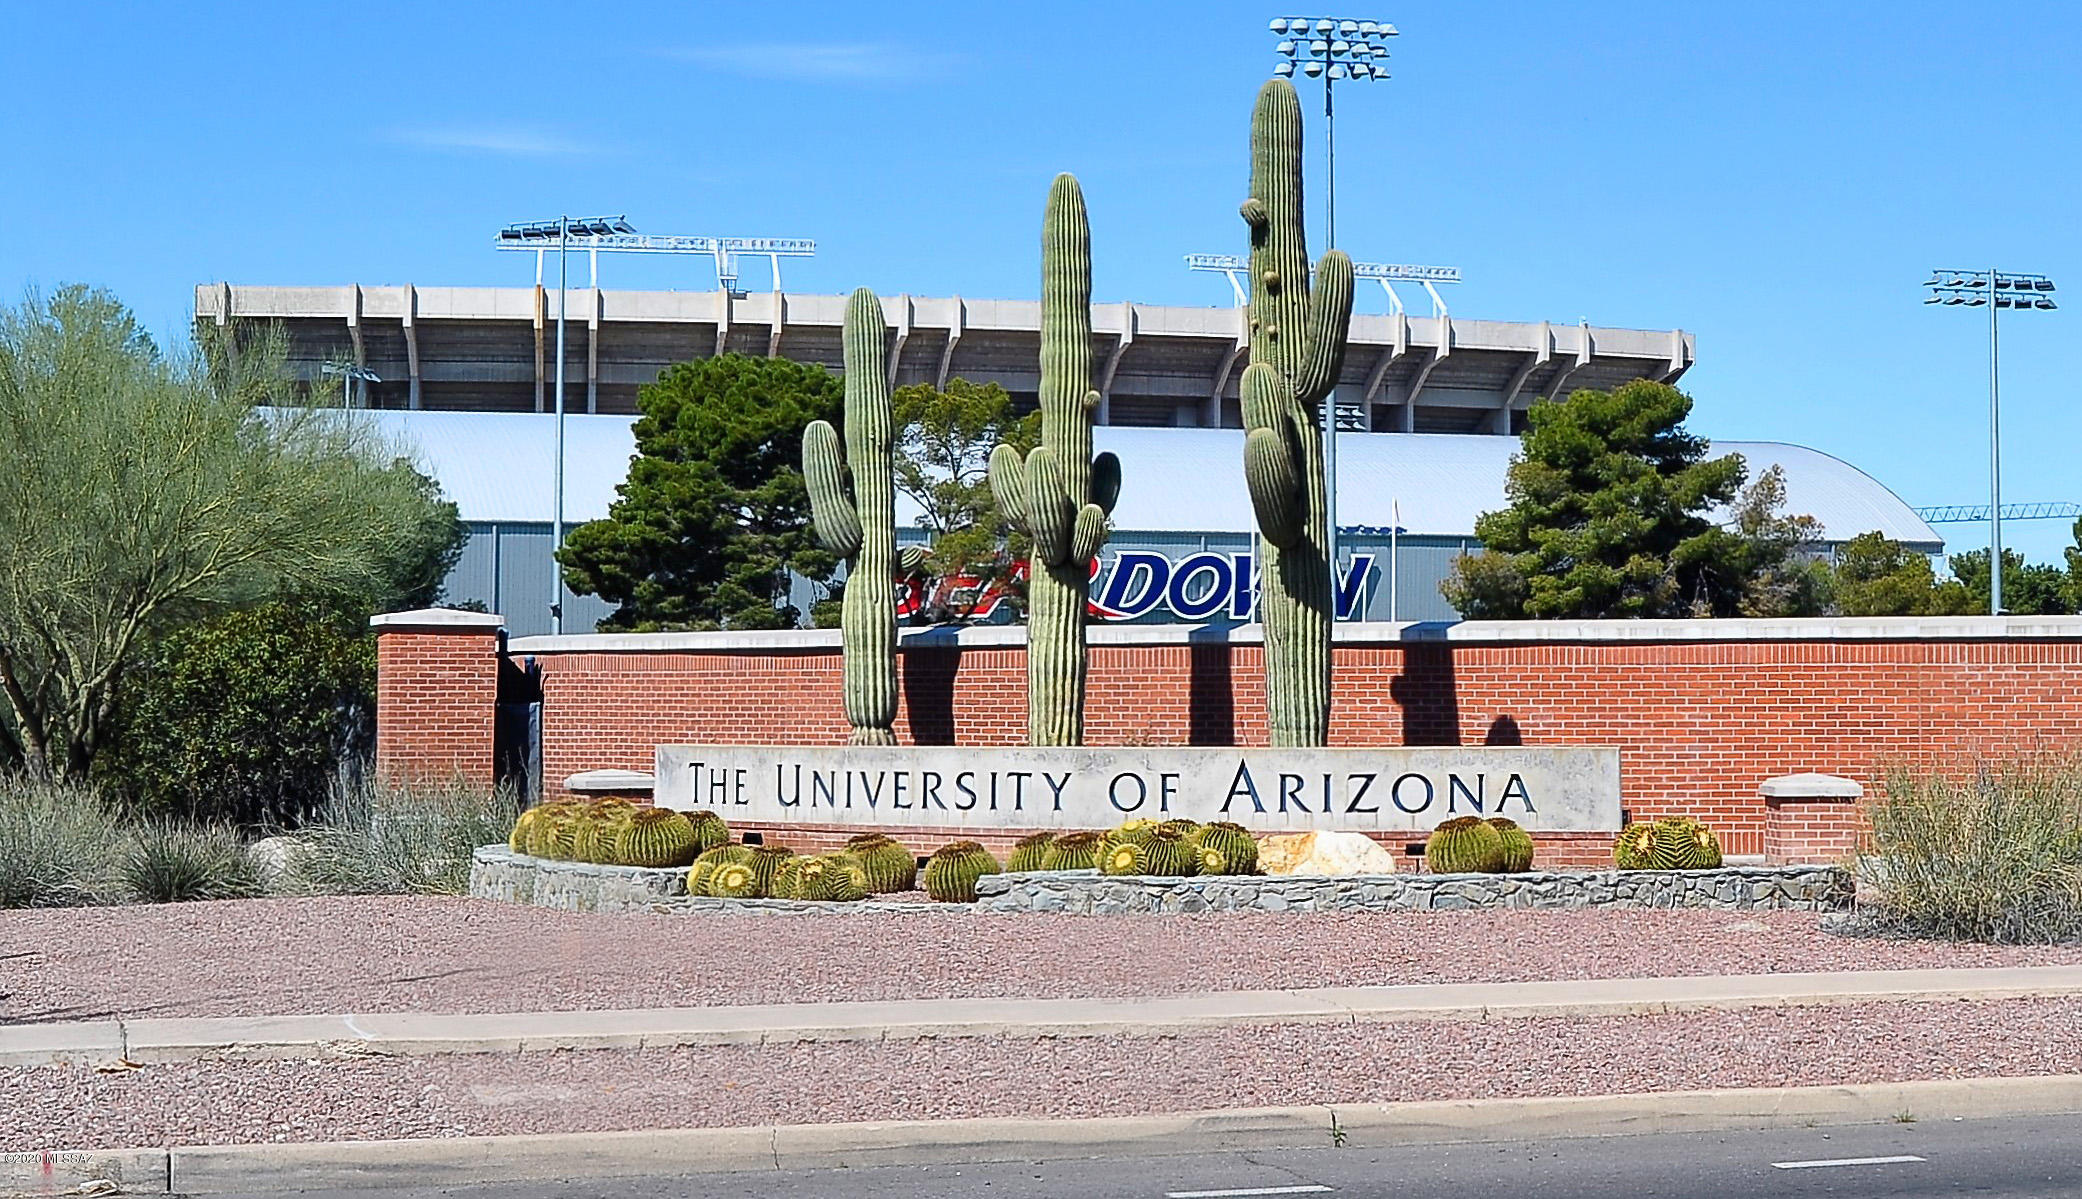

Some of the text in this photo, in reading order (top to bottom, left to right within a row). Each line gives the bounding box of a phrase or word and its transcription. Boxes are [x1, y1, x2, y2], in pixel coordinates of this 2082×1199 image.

[687, 757, 1538, 814] THE UNIVERSITY OF ARIZONA
